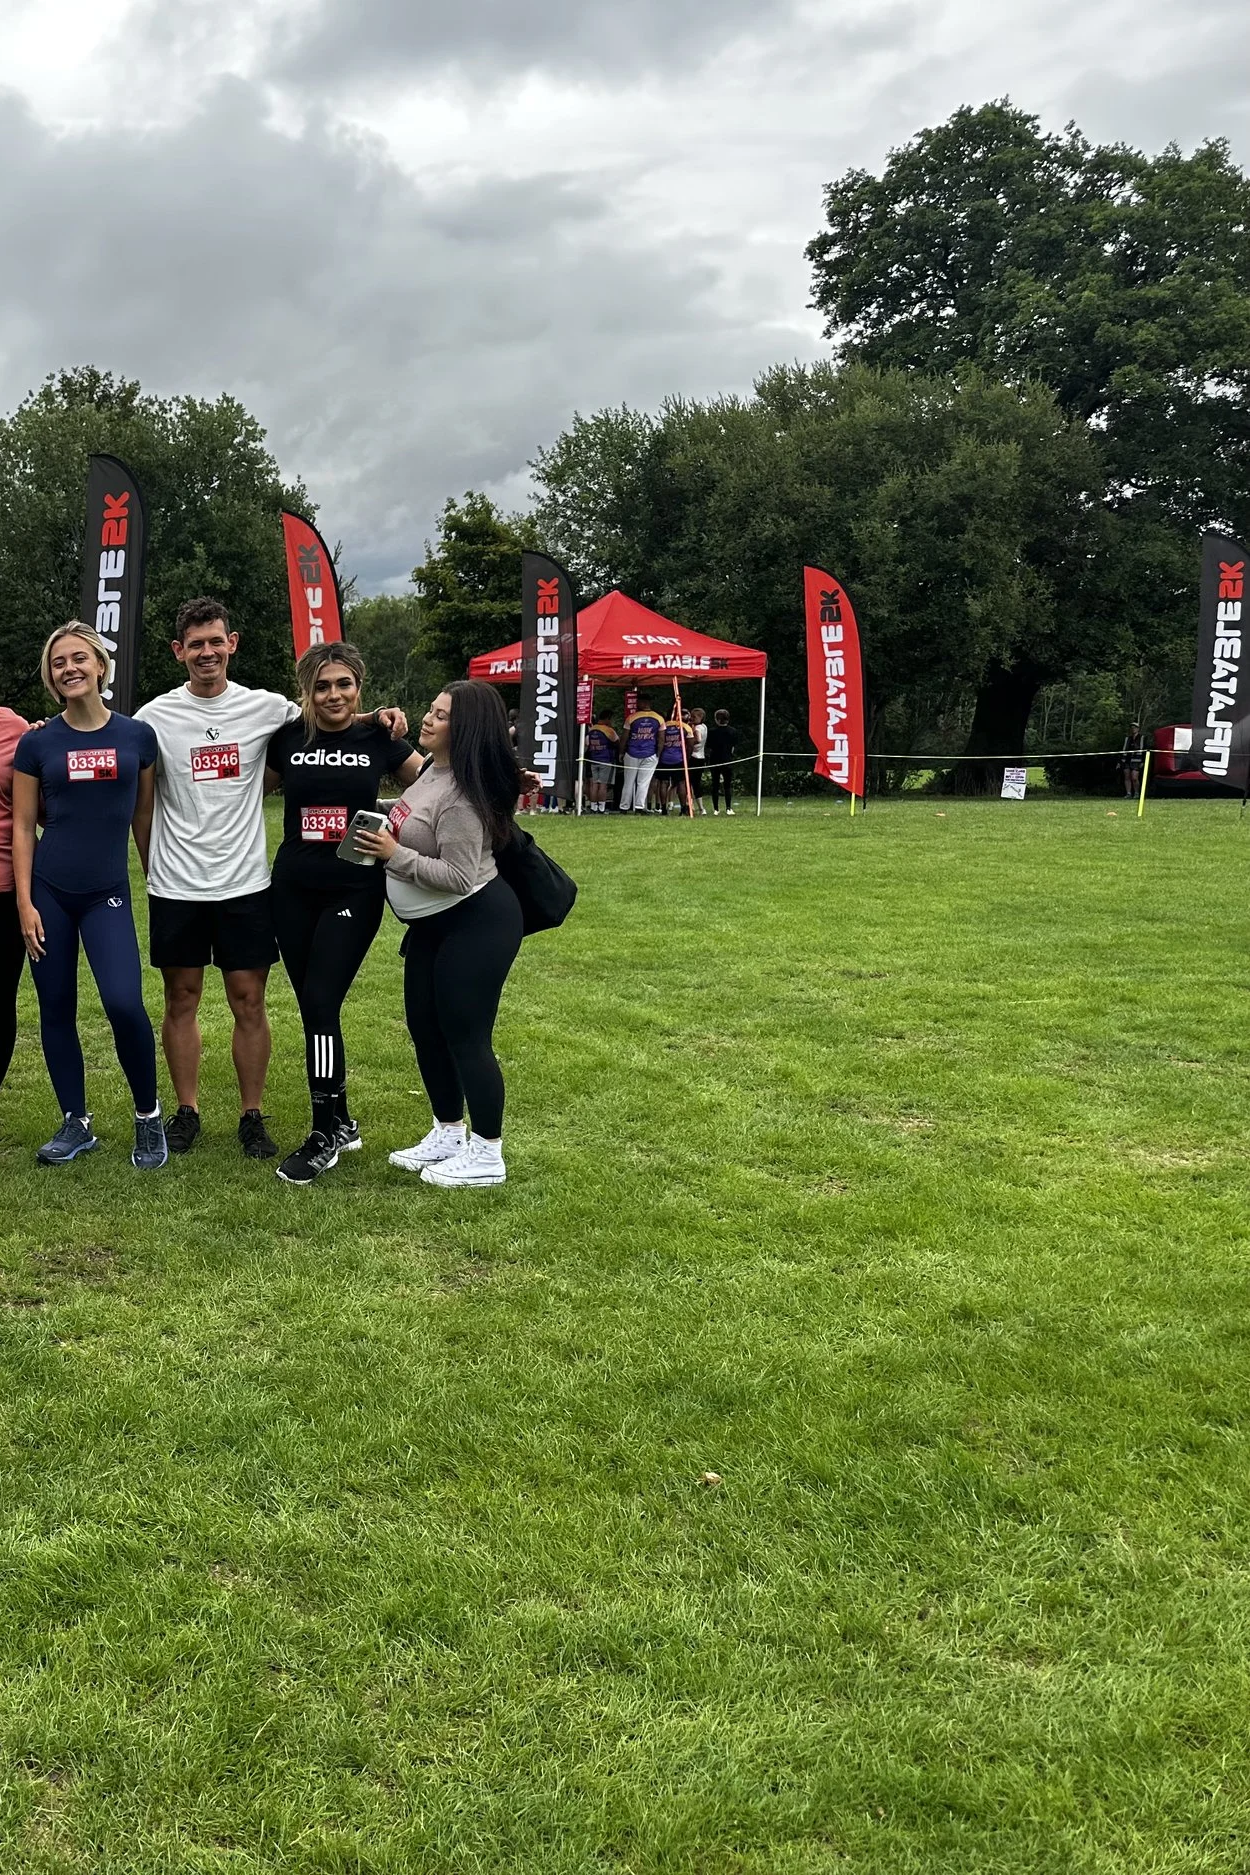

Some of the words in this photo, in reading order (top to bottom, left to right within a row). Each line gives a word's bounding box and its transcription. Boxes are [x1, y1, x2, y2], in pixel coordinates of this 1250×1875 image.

[622, 634, 682, 647] START
[69, 756, 115, 770] 03345
[193, 752, 238, 770] 03346
[291, 749, 370, 767] adidas
[99, 769, 112, 778] 5K
[223, 768, 236, 777] 5K
[302, 816, 346, 830] 03343
[328, 831, 342, 840] 5K
